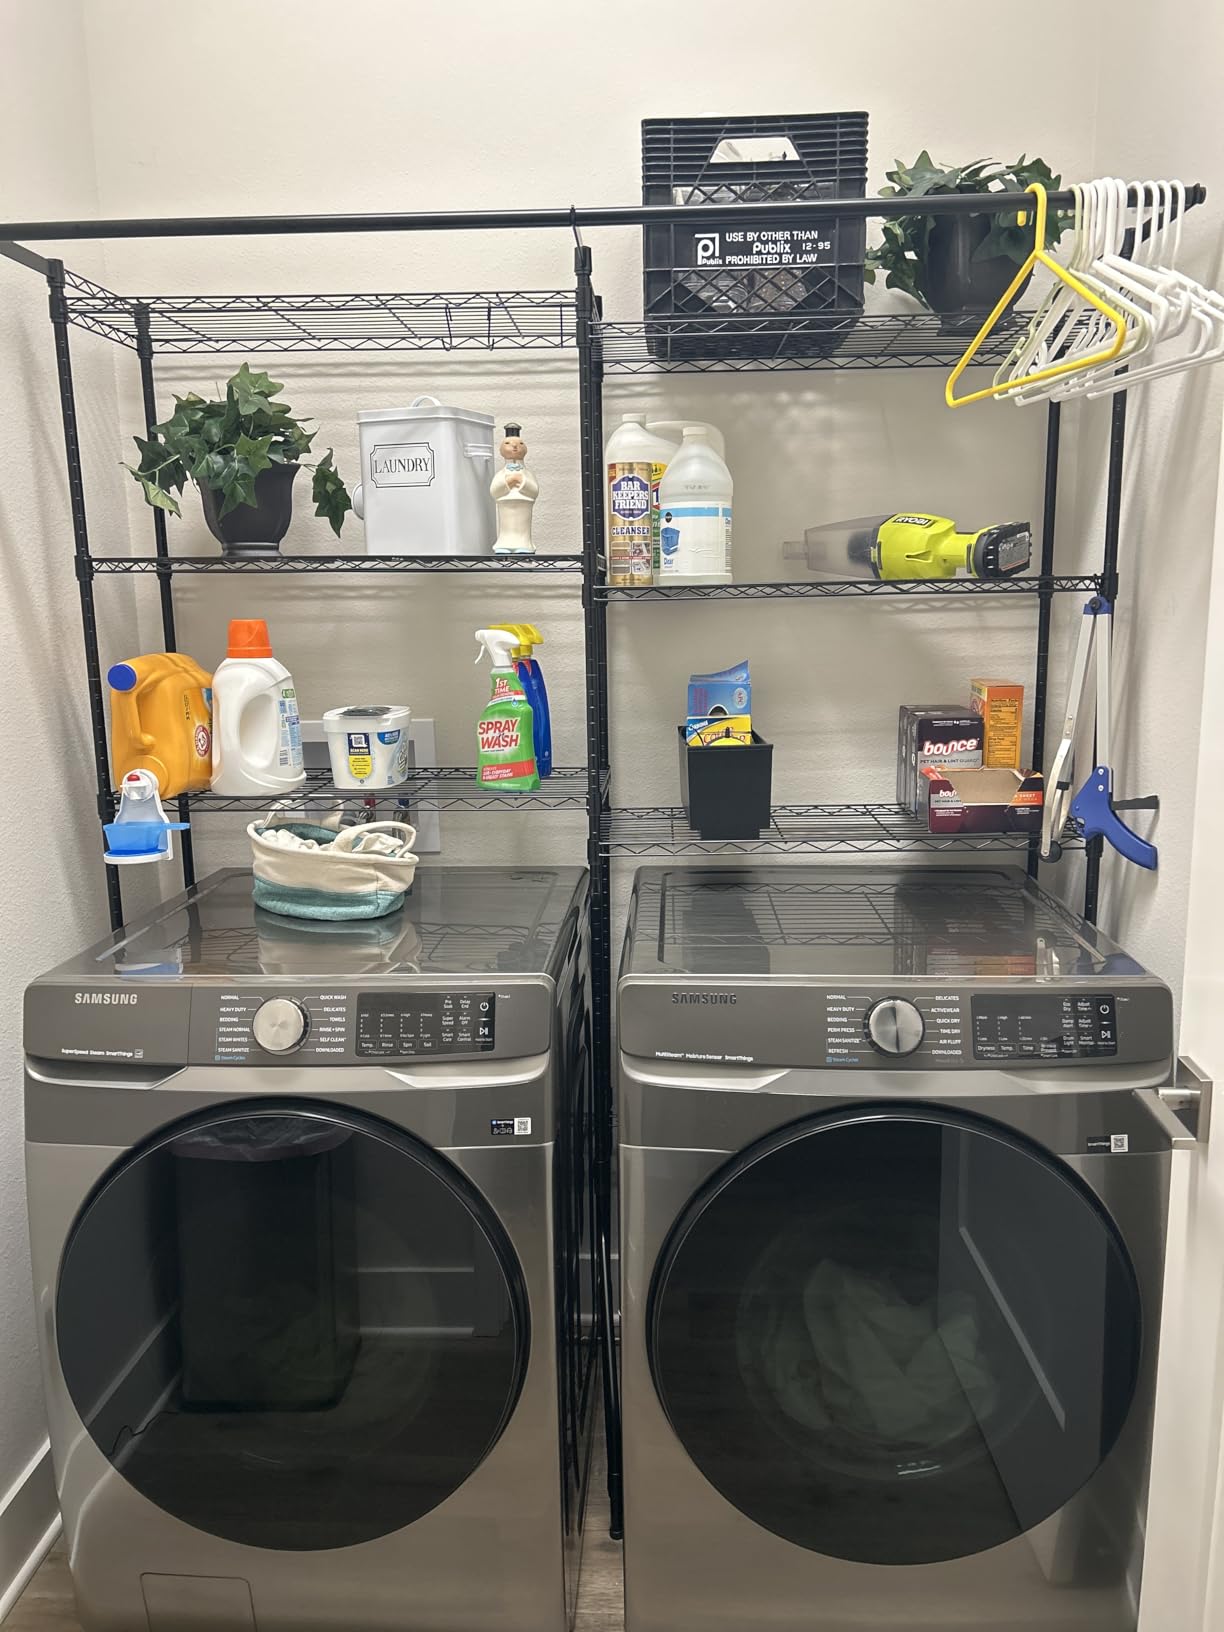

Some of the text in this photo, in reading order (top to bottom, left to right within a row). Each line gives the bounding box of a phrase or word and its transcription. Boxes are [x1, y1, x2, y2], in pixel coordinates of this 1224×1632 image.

[726, 230, 818, 242] USE BY OTHER THAN
[753, 241, 830, 254] Publix 12-95
[726, 254, 818, 264] PROHIBITED BY LAW
[374, 458, 430, 474] LAUNDRY
[620, 481, 640, 490] BAR
[613, 490, 648, 500] KEEPERS
[614, 500, 647, 510] FRIEND
[896, 517, 929, 526] RYOBI
[496, 678, 508, 688] 1ST
[494, 686, 510, 694] TIME
[478, 719, 518, 736] SPRAY
[481, 734, 519, 750] WASH
[924, 739, 978, 756] bounce
[74, 993, 138, 1004] SAMSUNG
[672, 992, 737, 1004] SAMSUNG
